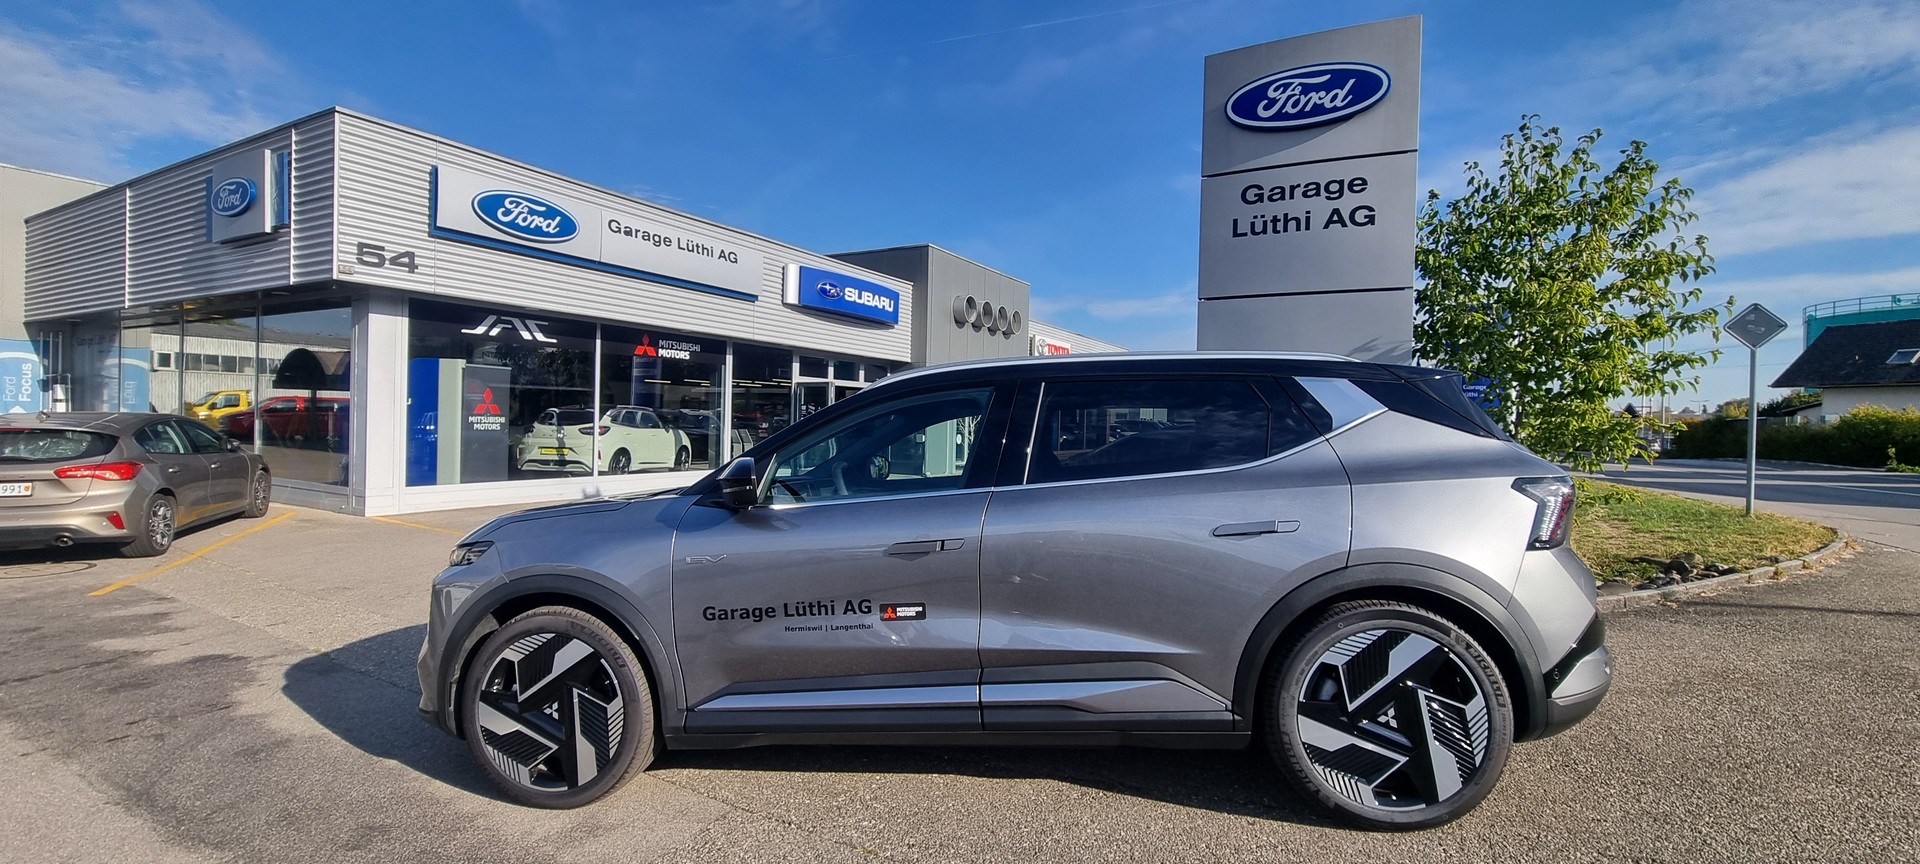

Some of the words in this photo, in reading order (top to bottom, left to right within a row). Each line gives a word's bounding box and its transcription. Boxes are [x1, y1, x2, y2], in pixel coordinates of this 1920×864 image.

[1257, 74, 1356, 118] Ford
[217, 184, 243, 210] Ford
[1240, 176, 1369, 206] Garage
[496, 197, 562, 234] Ford
[1232, 210, 1312, 238] Lüthi
[1322, 204, 1376, 230] AG
[607, 219, 673, 247] Garage
[677, 237, 714, 258] Lüthi
[717, 249, 739, 265] AG
[355, 241, 419, 274] 54
[844, 287, 894, 312] SUBARU
[460, 315, 558, 343] JAC
[658, 339, 701, 352] MITSUBISHI
[658, 348, 690, 360] MOTORS
[3, 376, 17, 402] Ford
[18, 362, 32, 402] Focus
[702, 605, 777, 623] Garage
[783, 600, 836, 618] Lüthi
[842, 599, 872, 615] AG
[784, 625, 823, 633] Hermiswil
[830, 622, 874, 633] Langenthal
[1467, 644, 1507, 708] MICHELIN
